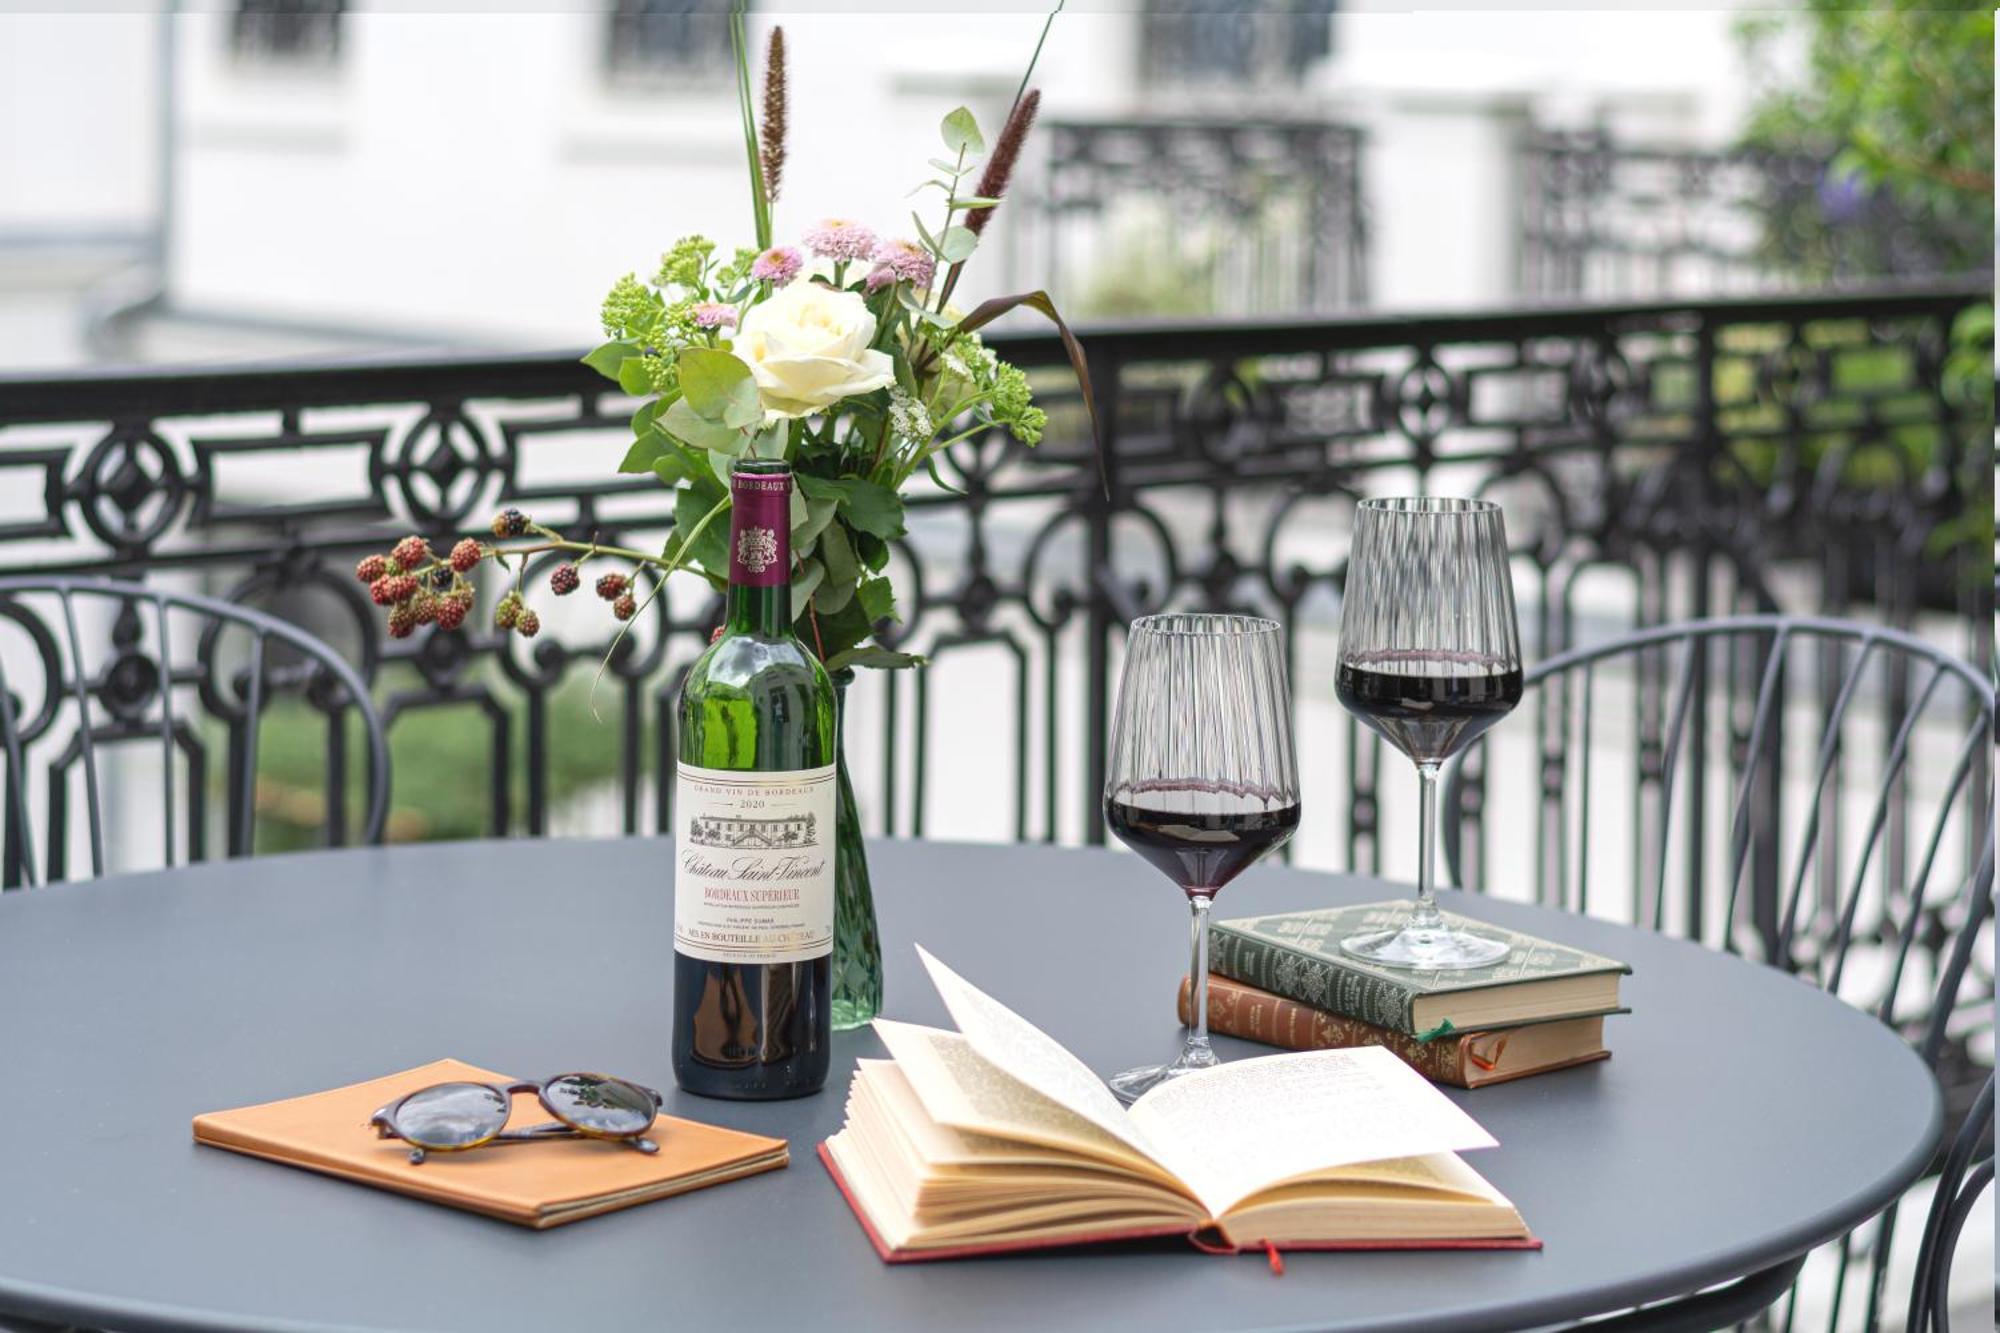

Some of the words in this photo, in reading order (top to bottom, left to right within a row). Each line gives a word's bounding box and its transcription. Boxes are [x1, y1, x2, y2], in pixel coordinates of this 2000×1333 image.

[738, 480, 784, 491] BORDEAUX
[694, 785, 722, 794] GRAND
[726, 788, 743, 796] VIN
[747, 788, 760, 797] DE
[765, 786, 814, 797] BORDEAUX
[740, 800, 765, 809] 2020
[681, 847, 728, 878] Château
[704, 887, 748, 901] BORDEAUX
[689, 928, 699, 938] MIS
[701, 930, 710, 939] EN
[712, 932, 759, 944] BOUTEILLE
